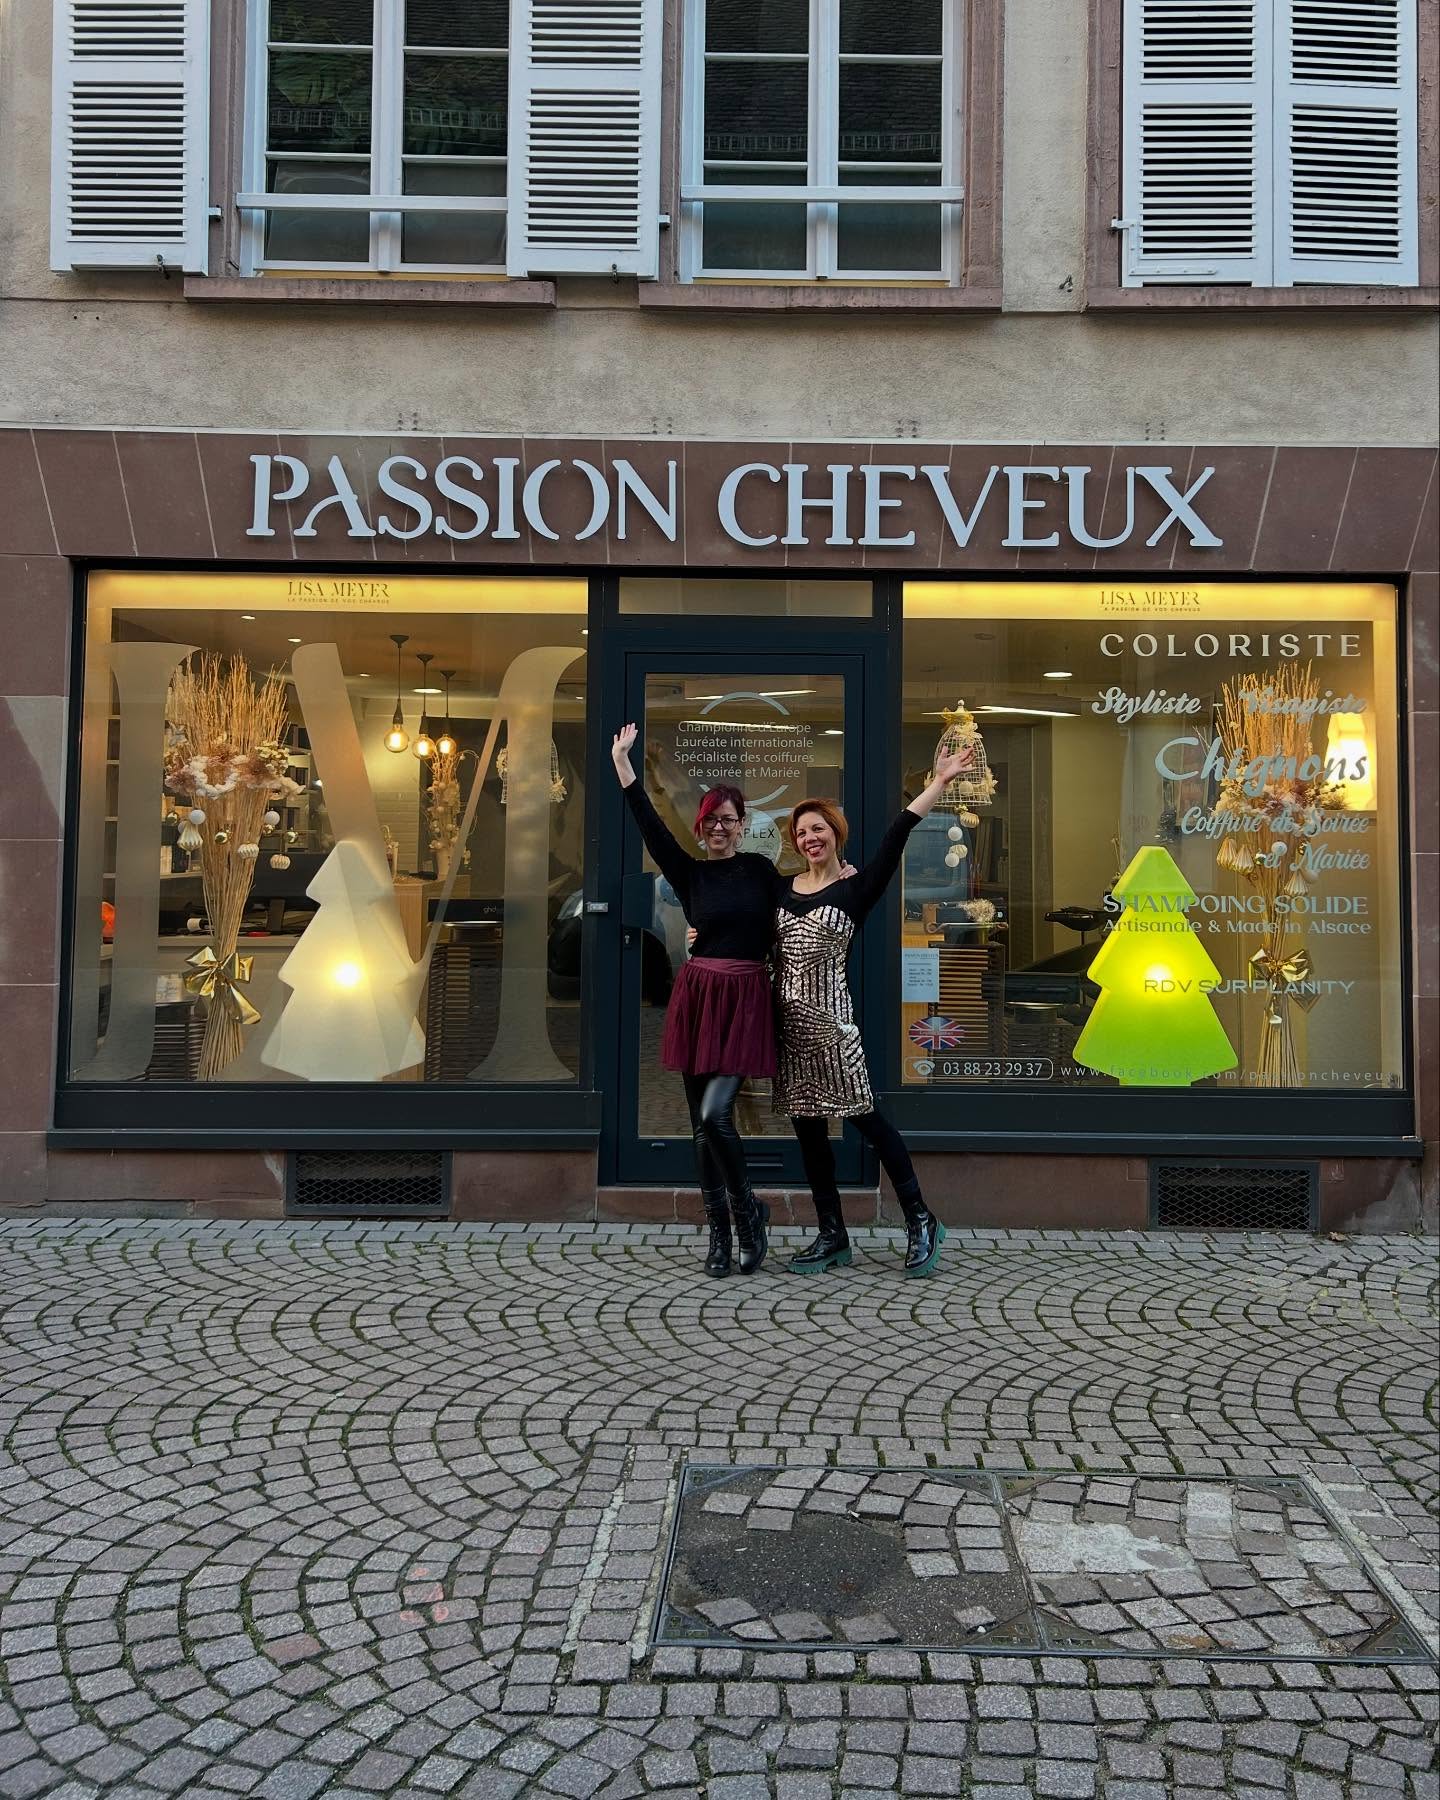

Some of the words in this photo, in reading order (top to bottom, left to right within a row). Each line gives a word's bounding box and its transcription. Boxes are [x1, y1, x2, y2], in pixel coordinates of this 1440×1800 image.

[246, 454, 677, 542] PASSION
[717, 462, 1225, 548] CHEVEUX
[288, 581, 324, 596] LISA
[331, 582, 390, 597] MEYER
[1101, 591, 1136, 605] LISA
[1143, 591, 1200, 606] MEYER
[1100, 633, 1361, 657] COLORISTE
[1091, 686, 1202, 724] Styliste
[1238, 686, 1368, 724] Visagiste
[679, 720, 758, 735] Championne
[675, 735, 727, 748] Lauréate
[730, 736, 814, 748] internationale
[674, 750, 738, 765] Spécialiste
[740, 751, 761, 763] des
[763, 752, 815, 763] coiffures
[688, 766, 704, 778] de
[706, 766, 742, 778] soirée
[744, 767, 757, 778] et
[759, 766, 801, 778] Mariée
[1155, 736, 1367, 797] Chignons
[1181, 806, 1264, 839] Coiffure
[1269, 810, 1295, 833] de
[1303, 807, 1370, 837] Soirée
[1289, 842, 1371, 872] Mariée
[1103, 894, 1265, 914] SHAMPOING
[1274, 894, 1369, 915] SOLIDE
[1103, 918, 1202, 933] Artisanale
[1208, 919, 1221, 933] &
[1226, 919, 1278, 934] Made
[1284, 919, 1302, 934] in
[1307, 919, 1371, 935] Alsace
[1144, 979, 1192, 993] RDV
[1198, 979, 1249, 994] SUR
[1252, 980, 1355, 995] PLANITY
[943, 1061, 959, 1075] 03
[963, 1062, 981, 1075] 88
[984, 1062, 1001, 1076] 23
[1005, 1062, 1022, 1076] 29
[1025, 1062, 1043, 1076] 37
